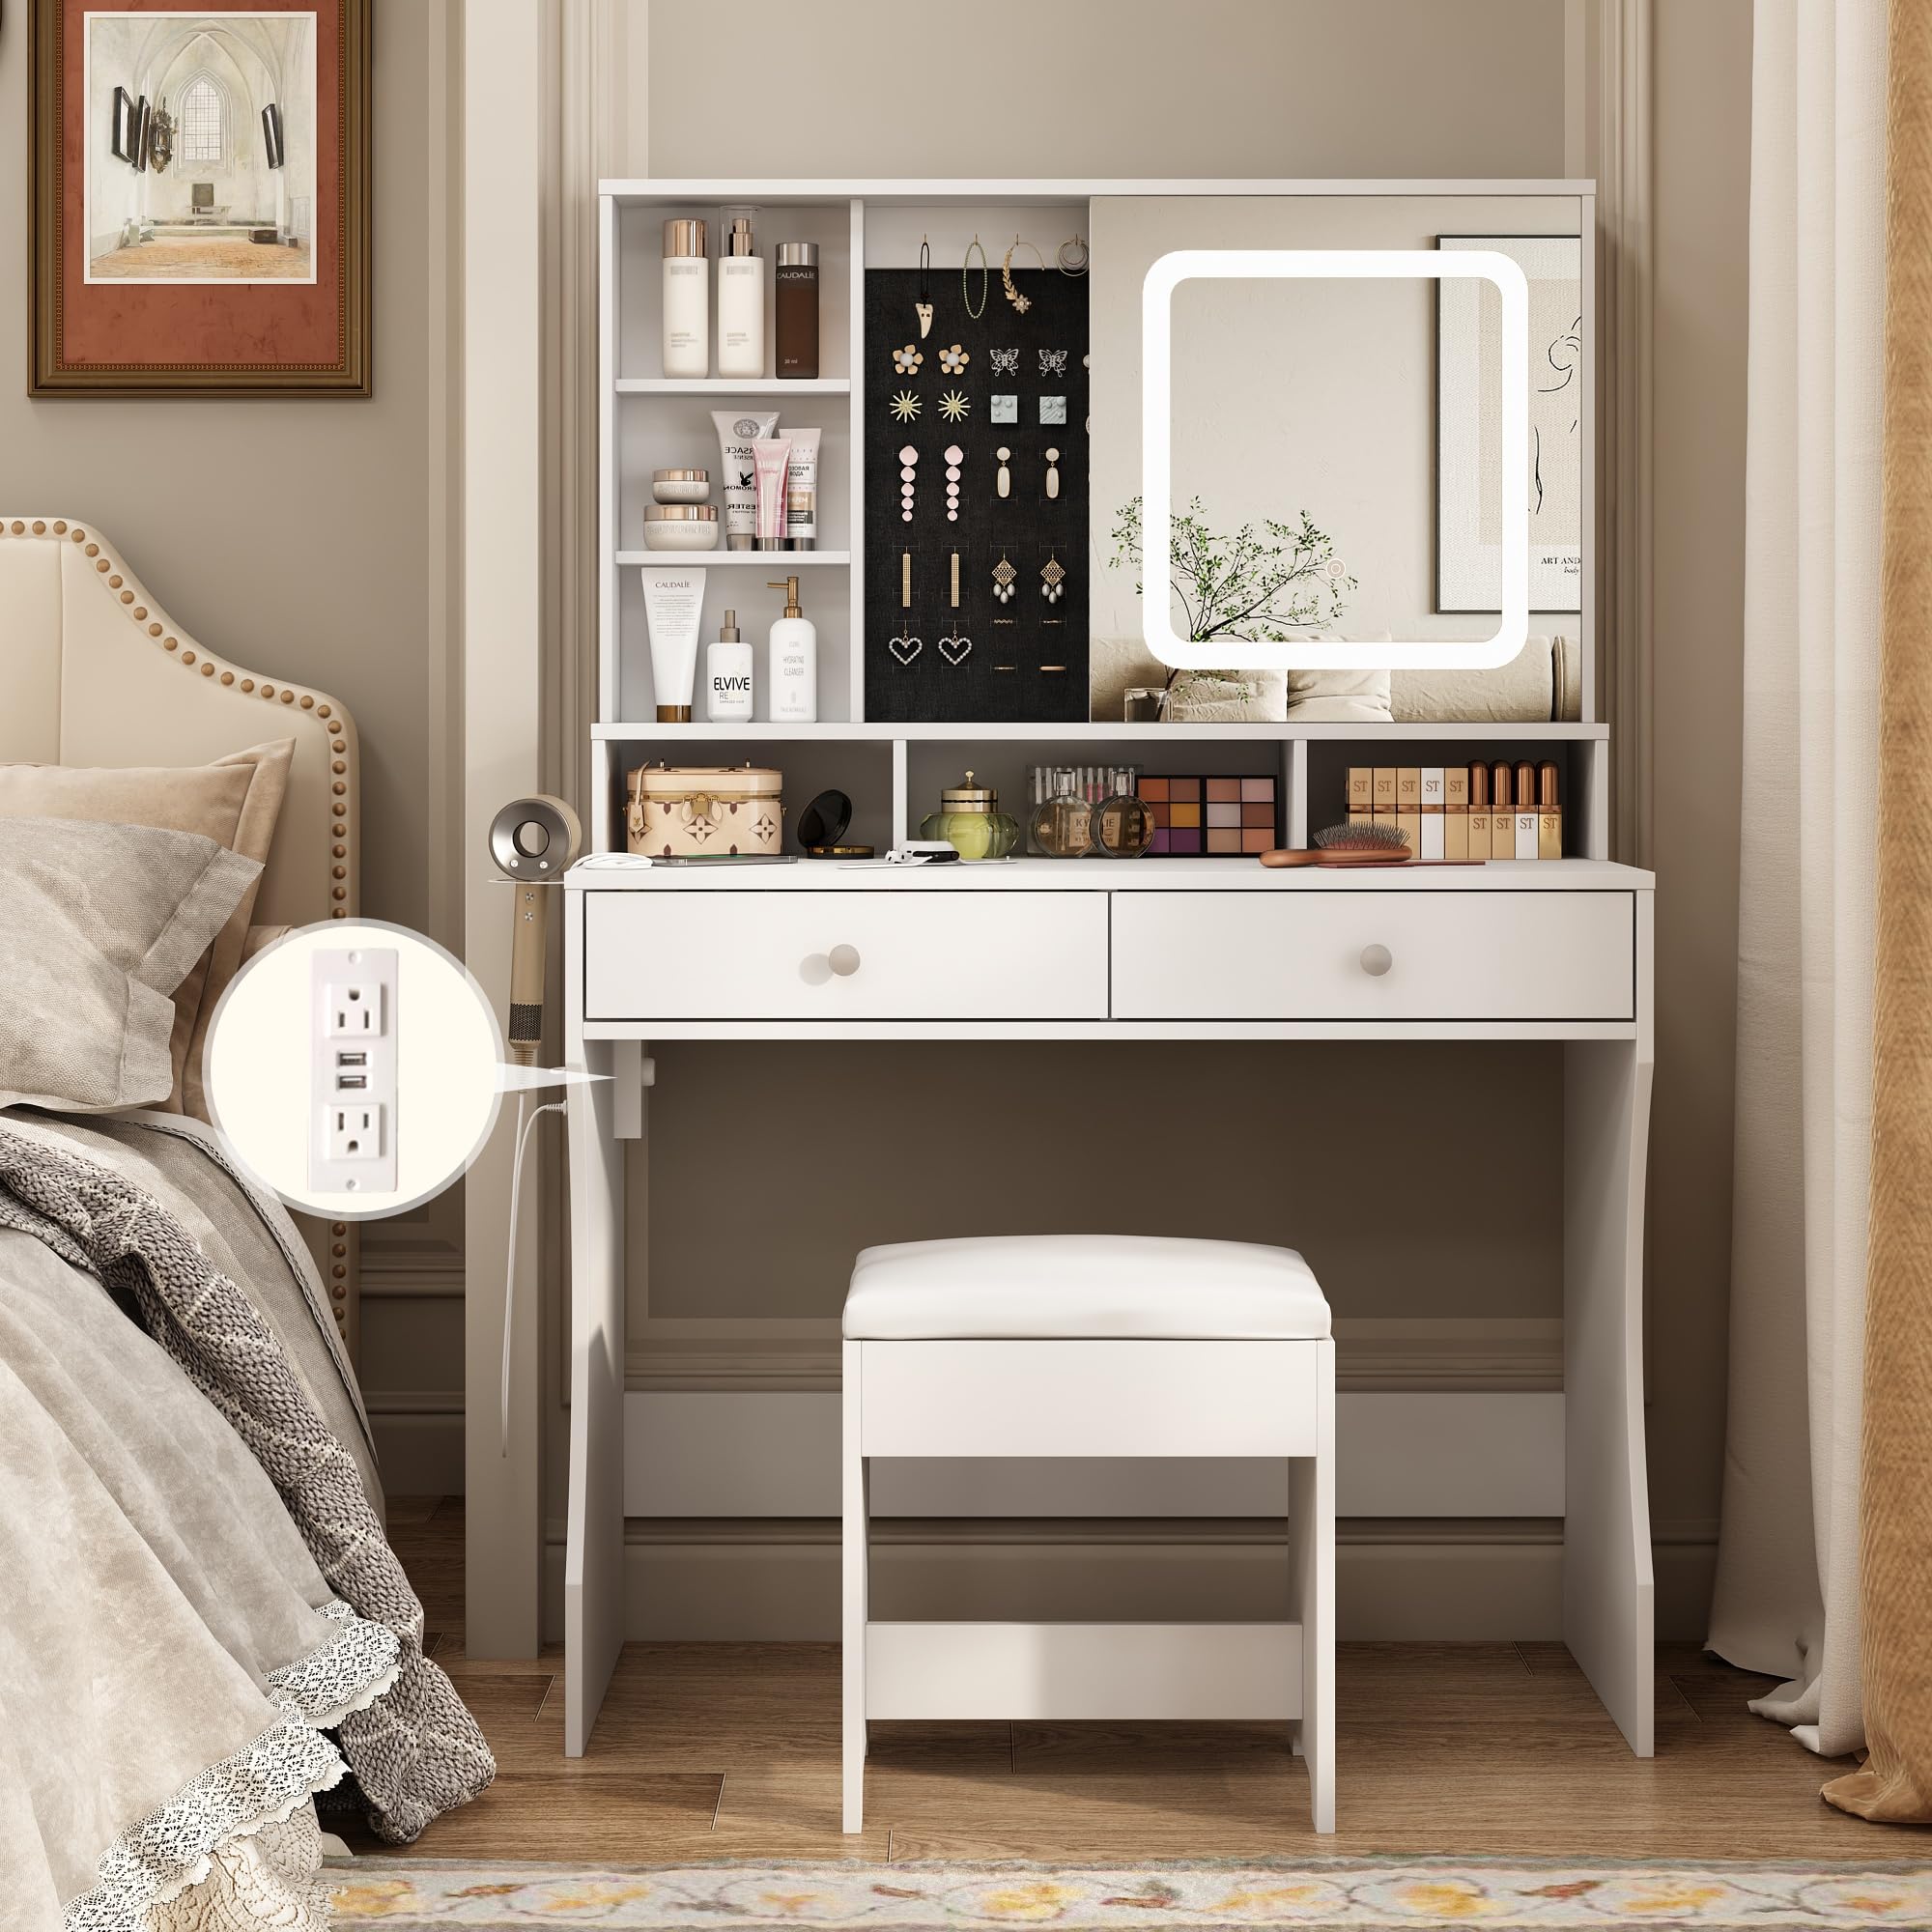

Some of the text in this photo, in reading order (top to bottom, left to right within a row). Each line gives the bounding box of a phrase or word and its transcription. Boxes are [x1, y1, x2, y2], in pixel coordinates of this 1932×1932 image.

[713, 676, 751, 691] ELVIVE
[1353, 781, 1368, 792] ST
[1378, 781, 1392, 792] ST
[1401, 781, 1416, 792] ST
[1426, 781, 1440, 792] ST
[1449, 781, 1464, 792] ST
[1473, 818, 1488, 830] ST
[1496, 818, 1511, 830] ST
[1520, 818, 1534, 830] ST
[1543, 818, 1558, 830] ST
